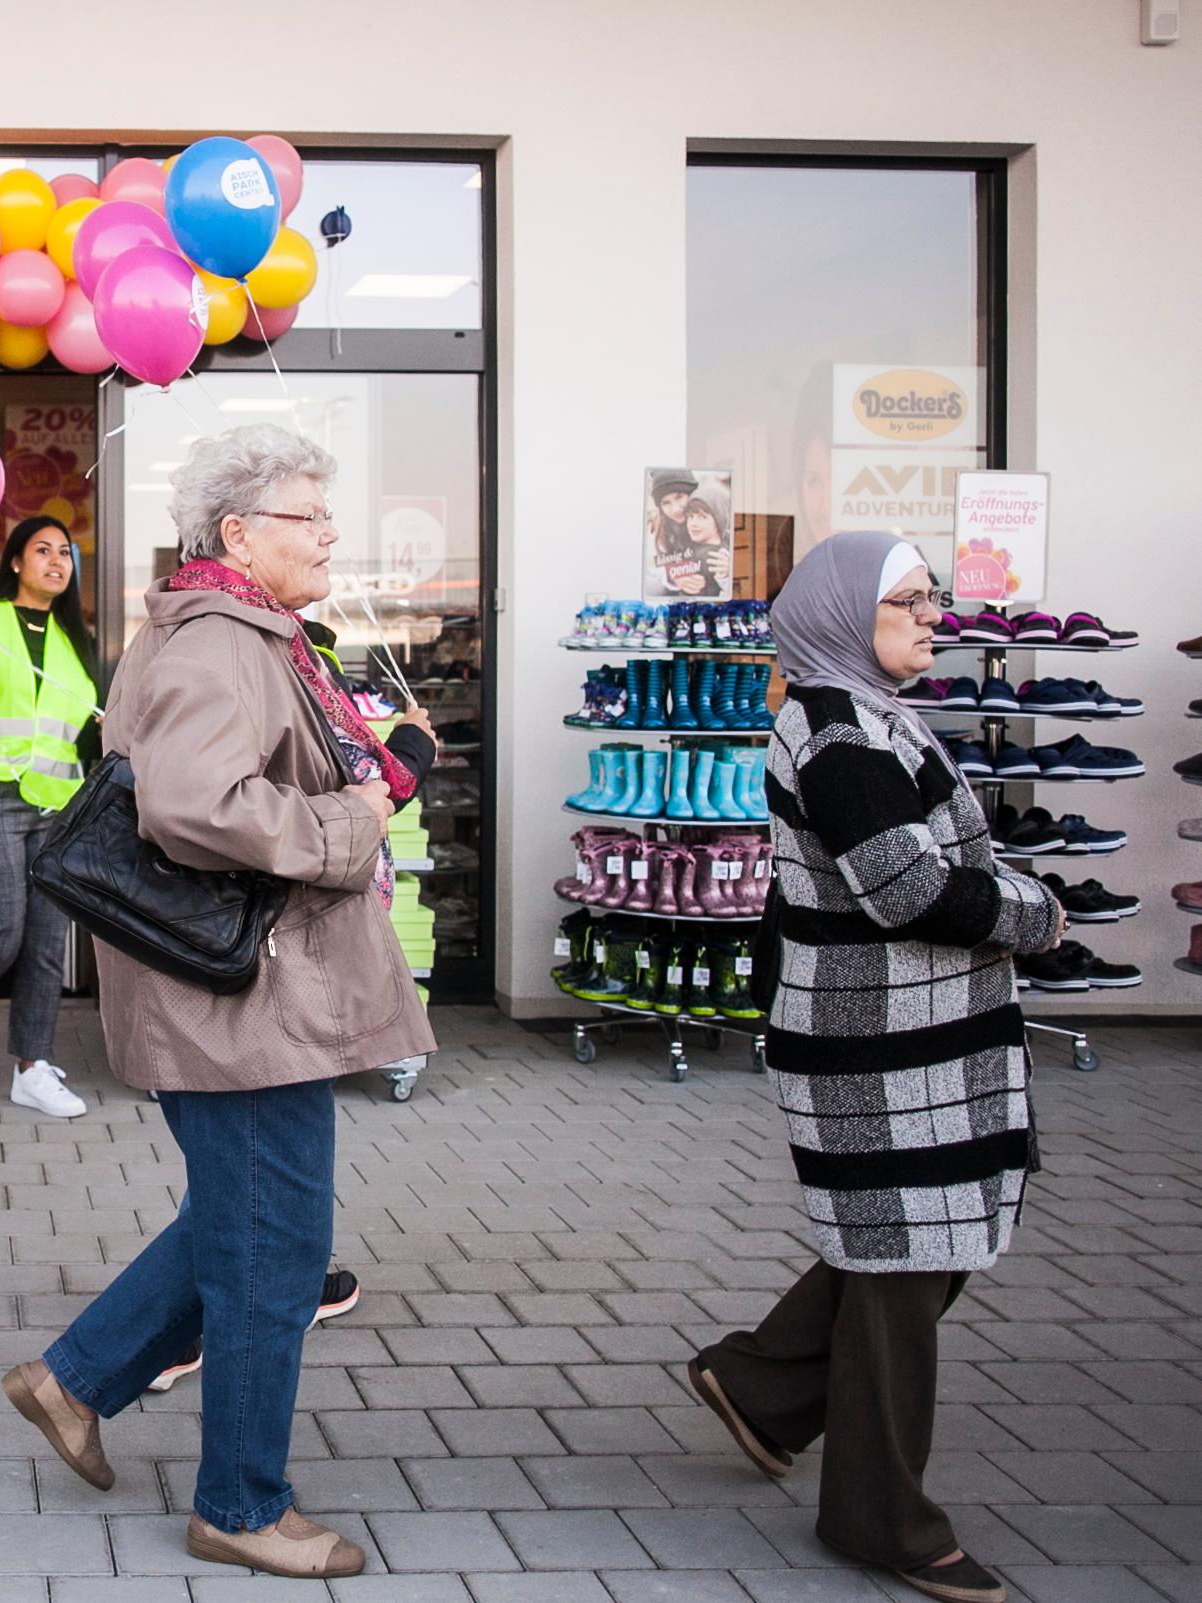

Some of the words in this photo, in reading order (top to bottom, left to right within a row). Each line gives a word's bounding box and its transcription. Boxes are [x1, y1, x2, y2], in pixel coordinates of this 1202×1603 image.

[232, 179, 262, 191] PARK
[20, 407, 95, 431] 20%
[890, 421, 903, 432] by
[907, 421, 933, 431] Gerli
[841, 501, 955, 517] ADVENTUR
[960, 496, 1044, 512] Eröffnungs-
[968, 511, 1037, 527] Angebote
[959, 568, 990, 585] NEU
